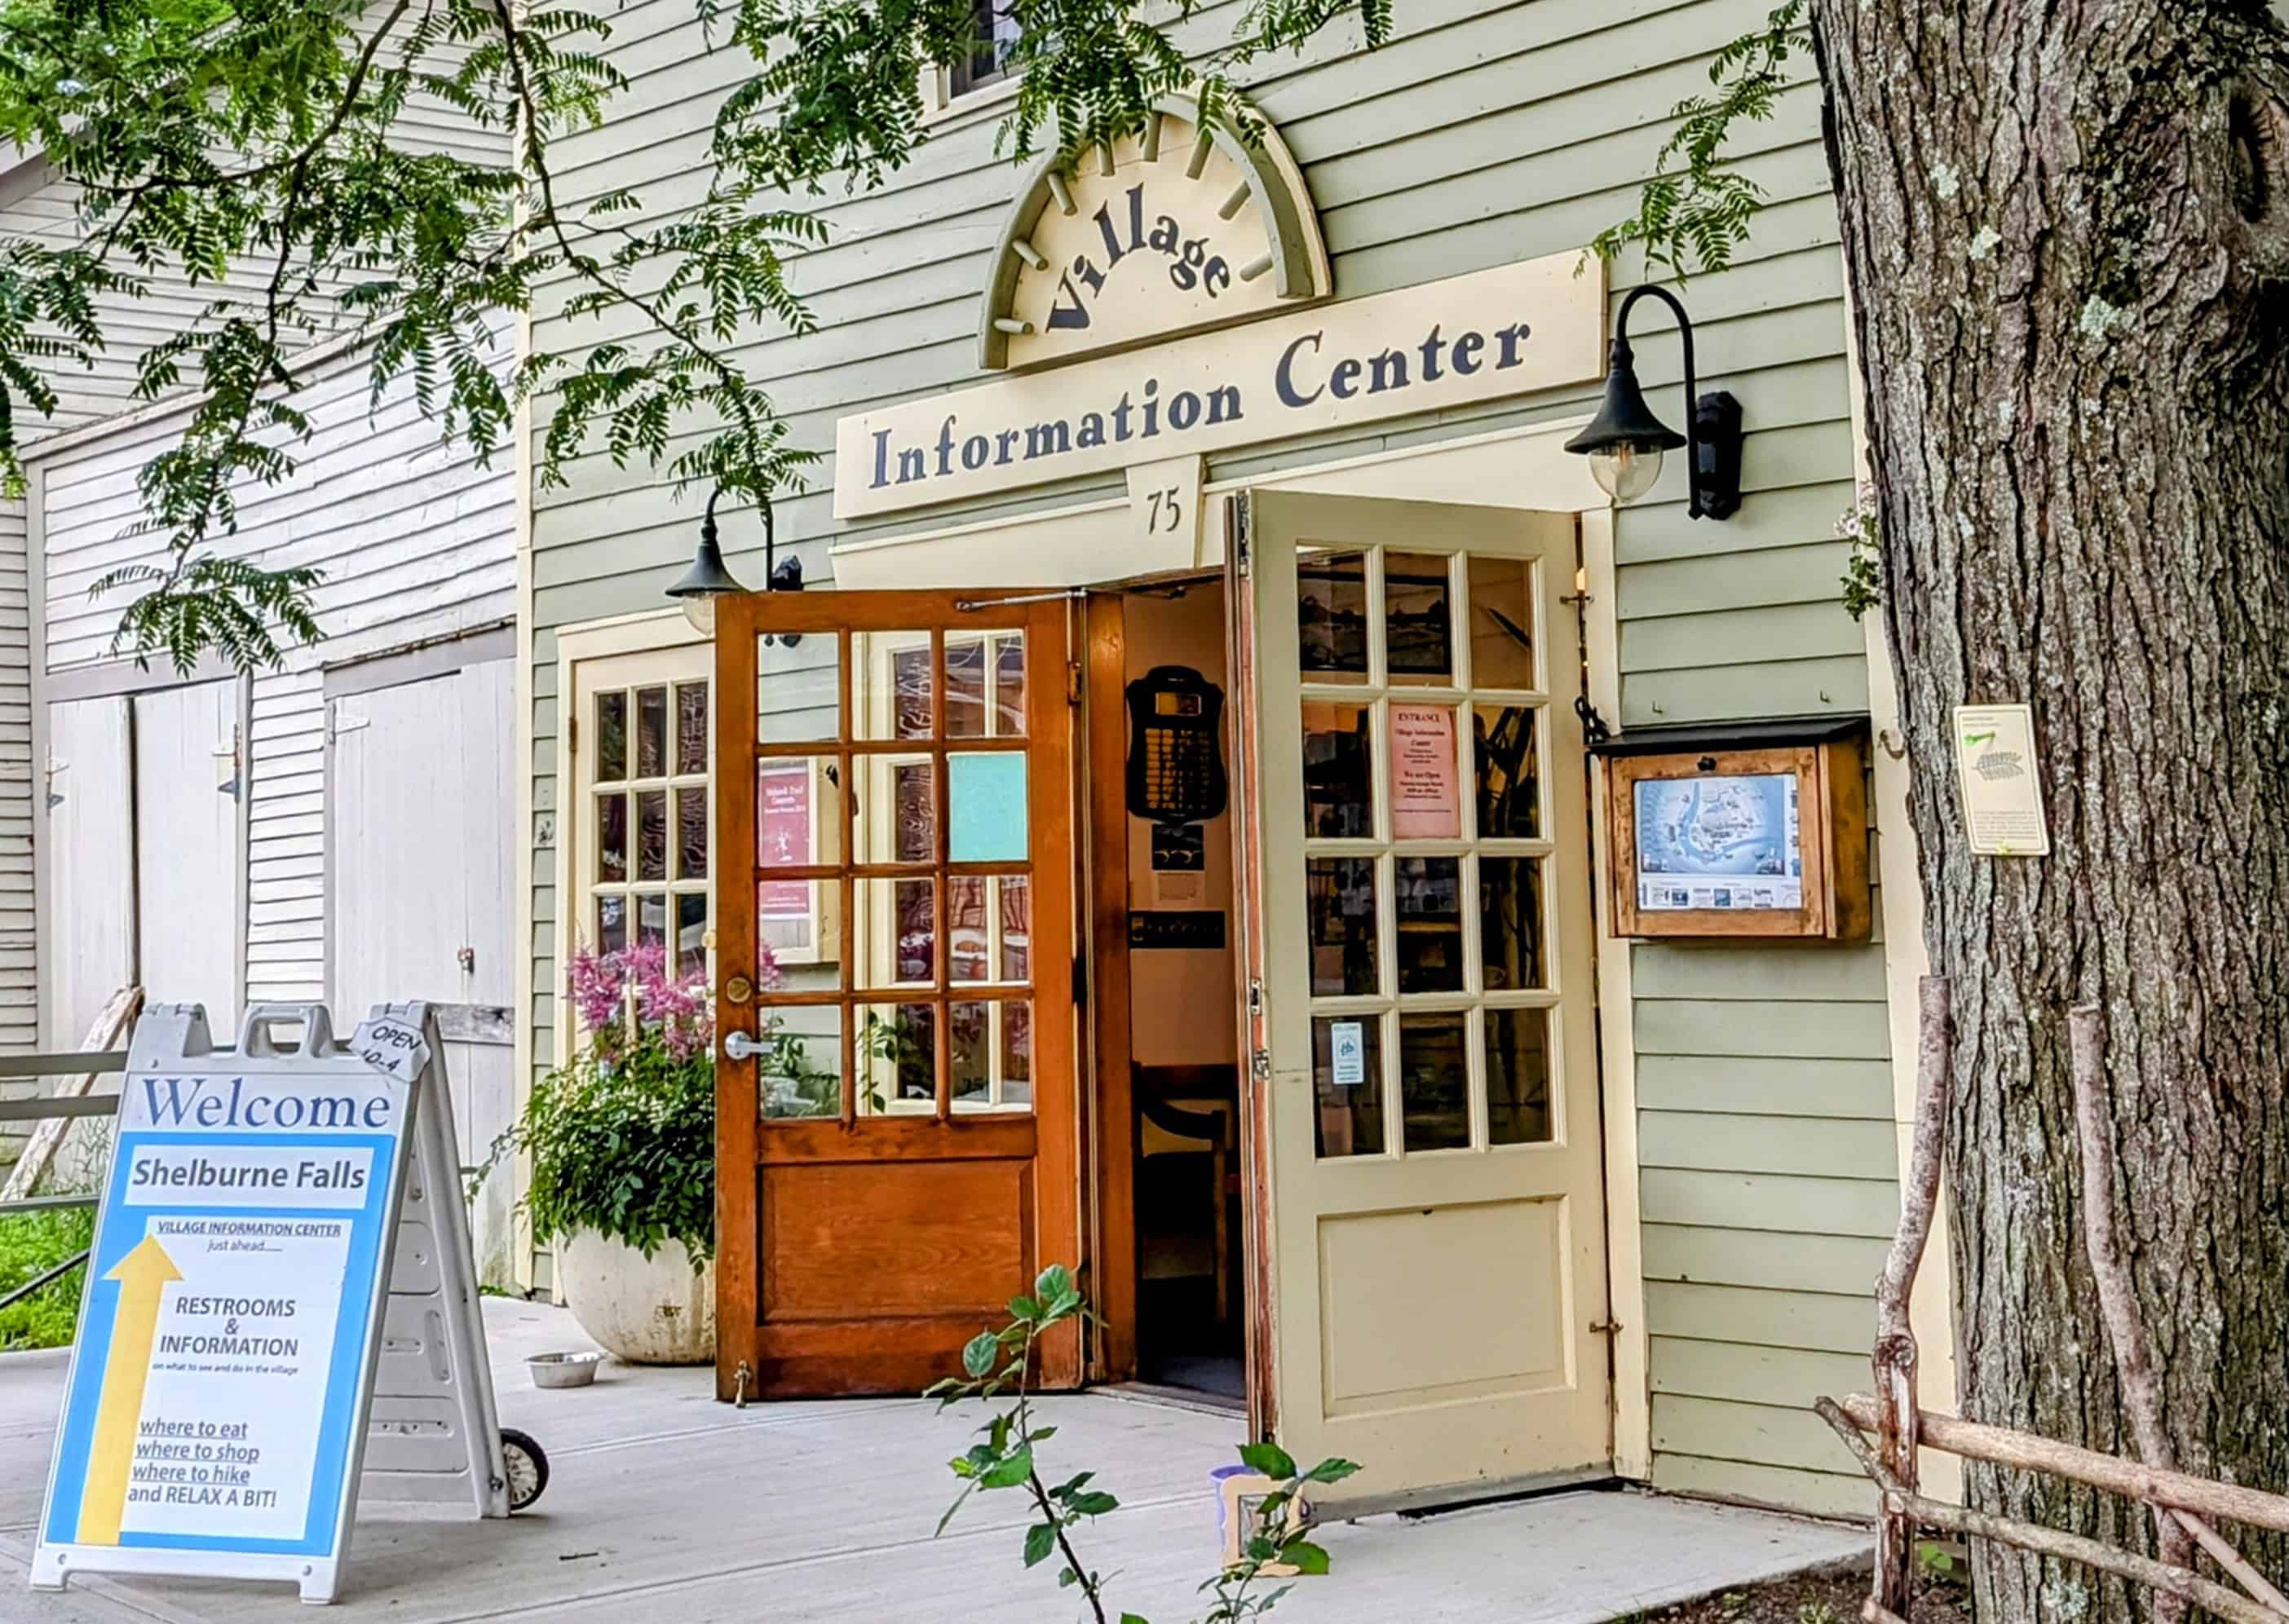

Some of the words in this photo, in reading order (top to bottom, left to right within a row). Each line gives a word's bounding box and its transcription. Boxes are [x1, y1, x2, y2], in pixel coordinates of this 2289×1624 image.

[1045, 182, 1230, 333] Village
[868, 378, 1244, 488] Information
[1275, 323, 1531, 408] Center
[1147, 485, 1181, 535] 75
[372, 1026, 422, 1050] OPEN
[143, 1076, 390, 1128] Welcome
[131, 1158, 288, 1187] Shelburne
[296, 1160, 365, 1189] Falls
[157, 1221, 205, 1234] VILLAGE
[207, 1221, 293, 1236] INFORMATION
[294, 1224, 342, 1237] CENTER
[207, 1240, 228, 1252] just
[175, 1296, 296, 1317] RESTROOMS
[224, 1317, 239, 1335] &
[159, 1335, 298, 1356] INFORMATION
[166, 1363, 186, 1371] what
[188, 1363, 197, 1371] to
[214, 1364, 231, 1372] and
[232, 1364, 243, 1372] do
[255, 1364, 268, 1373] the
[271, 1365, 299, 1376] village
[139, 1417, 194, 1436] where
[198, 1420, 216, 1436] to
[220, 1422, 248, 1438] eat
[136, 1440, 190, 1459] where
[195, 1443, 212, 1459] to
[217, 1443, 260, 1464] shop
[133, 1462, 186, 1481] where
[191, 1465, 208, 1482] to
[213, 1465, 250, 1484] hike
[128, 1485, 161, 1503] and
[166, 1486, 222, 1505] RELAX
[224, 1489, 239, 1506] A
[243, 1490, 277, 1507] BIT!
